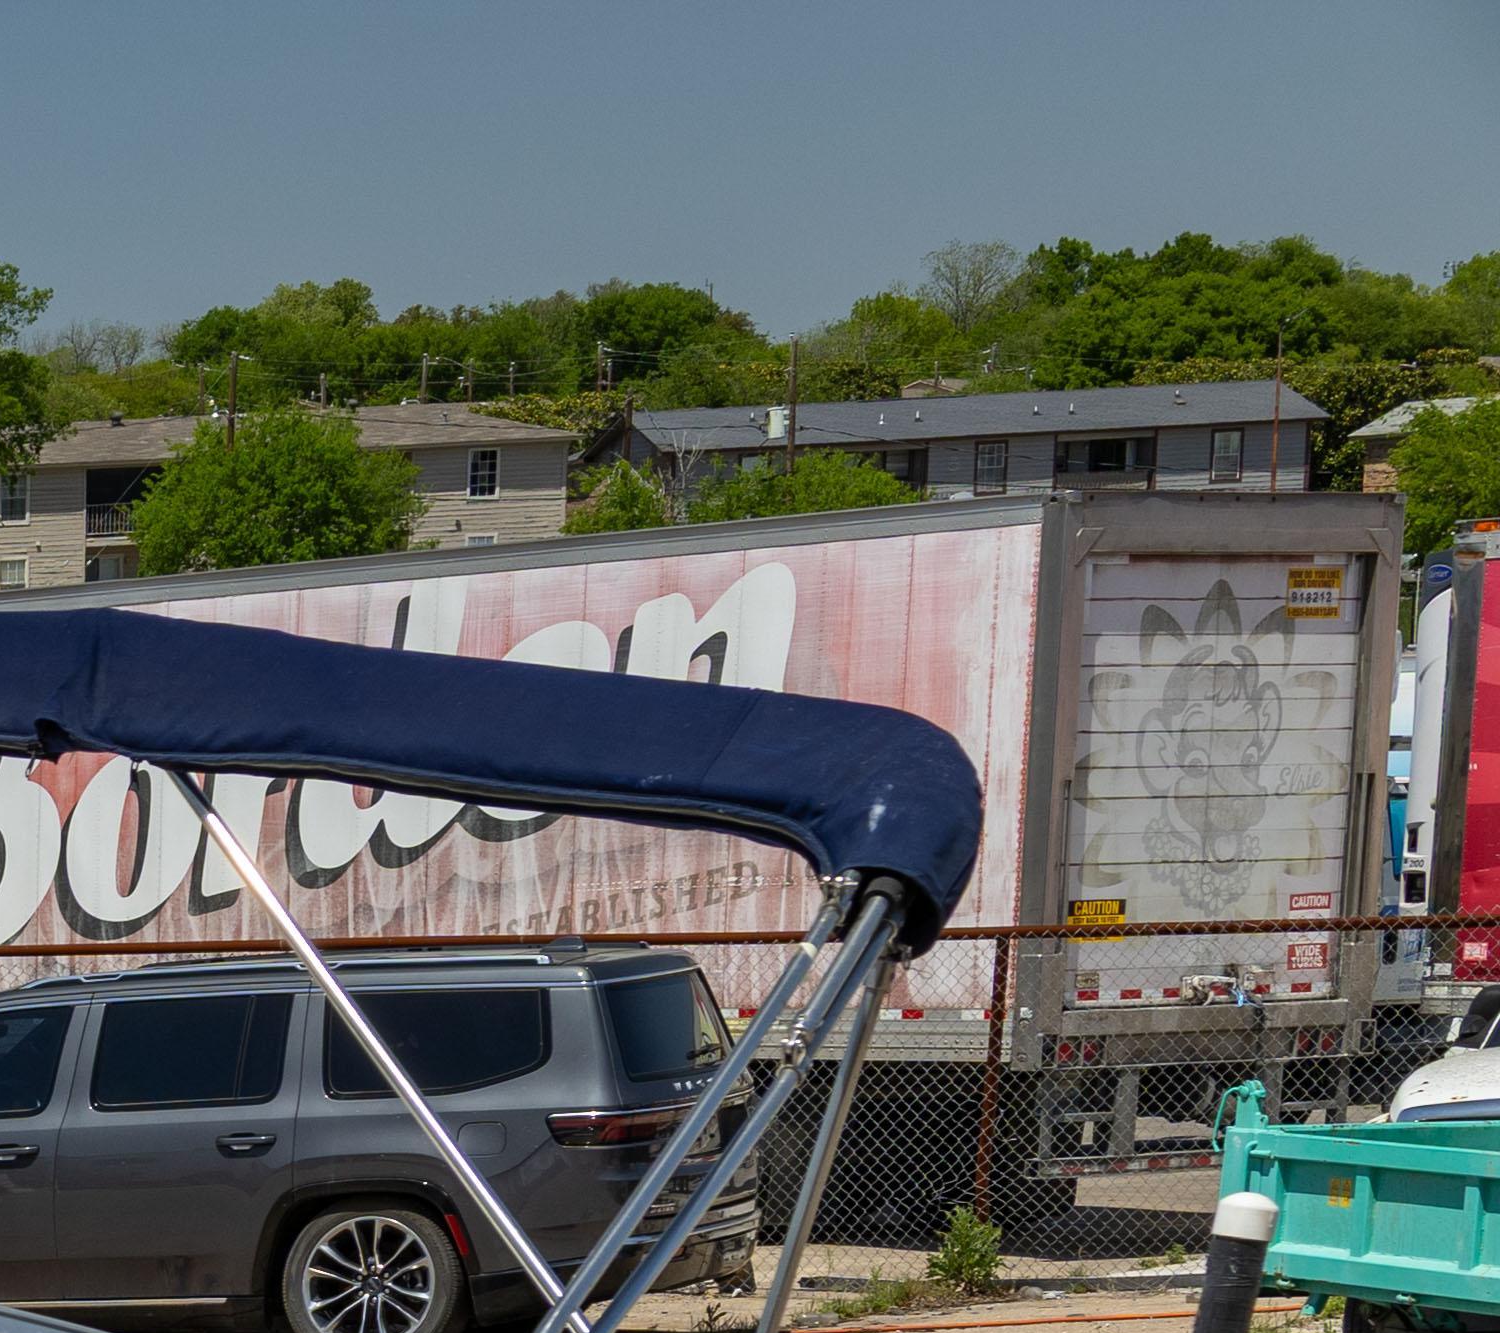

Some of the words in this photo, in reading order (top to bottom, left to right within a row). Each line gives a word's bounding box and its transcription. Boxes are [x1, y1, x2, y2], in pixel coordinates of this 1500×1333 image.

[1074, 901, 1120, 915] CAUTION
[1292, 896, 1329, 908] CAUTION
[1294, 945, 1322, 956] WIDE
[1291, 956, 1323, 968] TURNS
